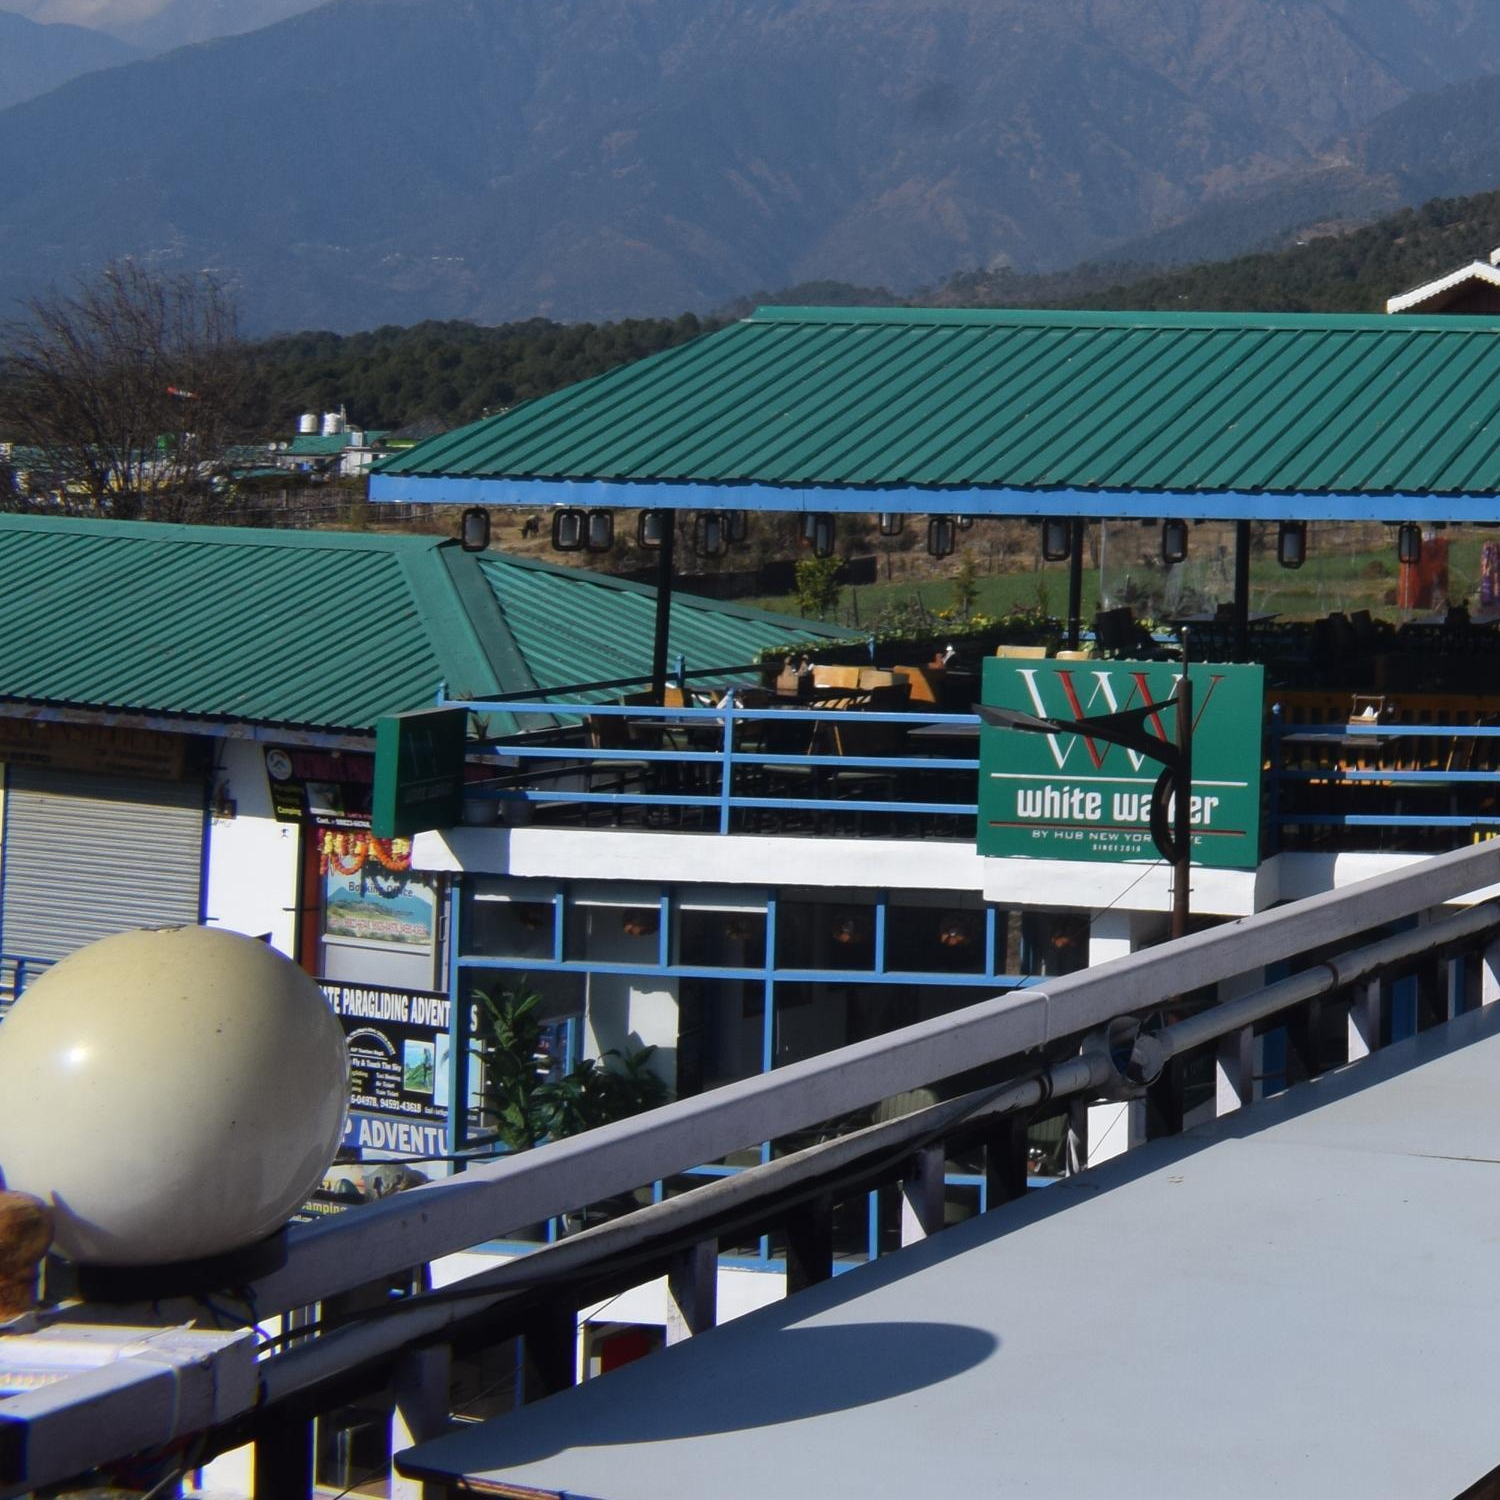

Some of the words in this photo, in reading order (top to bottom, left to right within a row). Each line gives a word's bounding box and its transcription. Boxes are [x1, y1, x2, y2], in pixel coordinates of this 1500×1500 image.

[1016, 784, 1102, 820] white
[1112, 789, 1220, 825] waer
[1032, 829, 1049, 839] BY
[1054, 830, 1084, 841] HUB
[1088, 831, 1121, 842] NEW
[1124, 833, 1153, 843] YOR
[342, 988, 409, 1023] PARAGLIDING
[411, 996, 478, 1032] ADVENTS
[359, 1118, 449, 1156] ADVENTU
